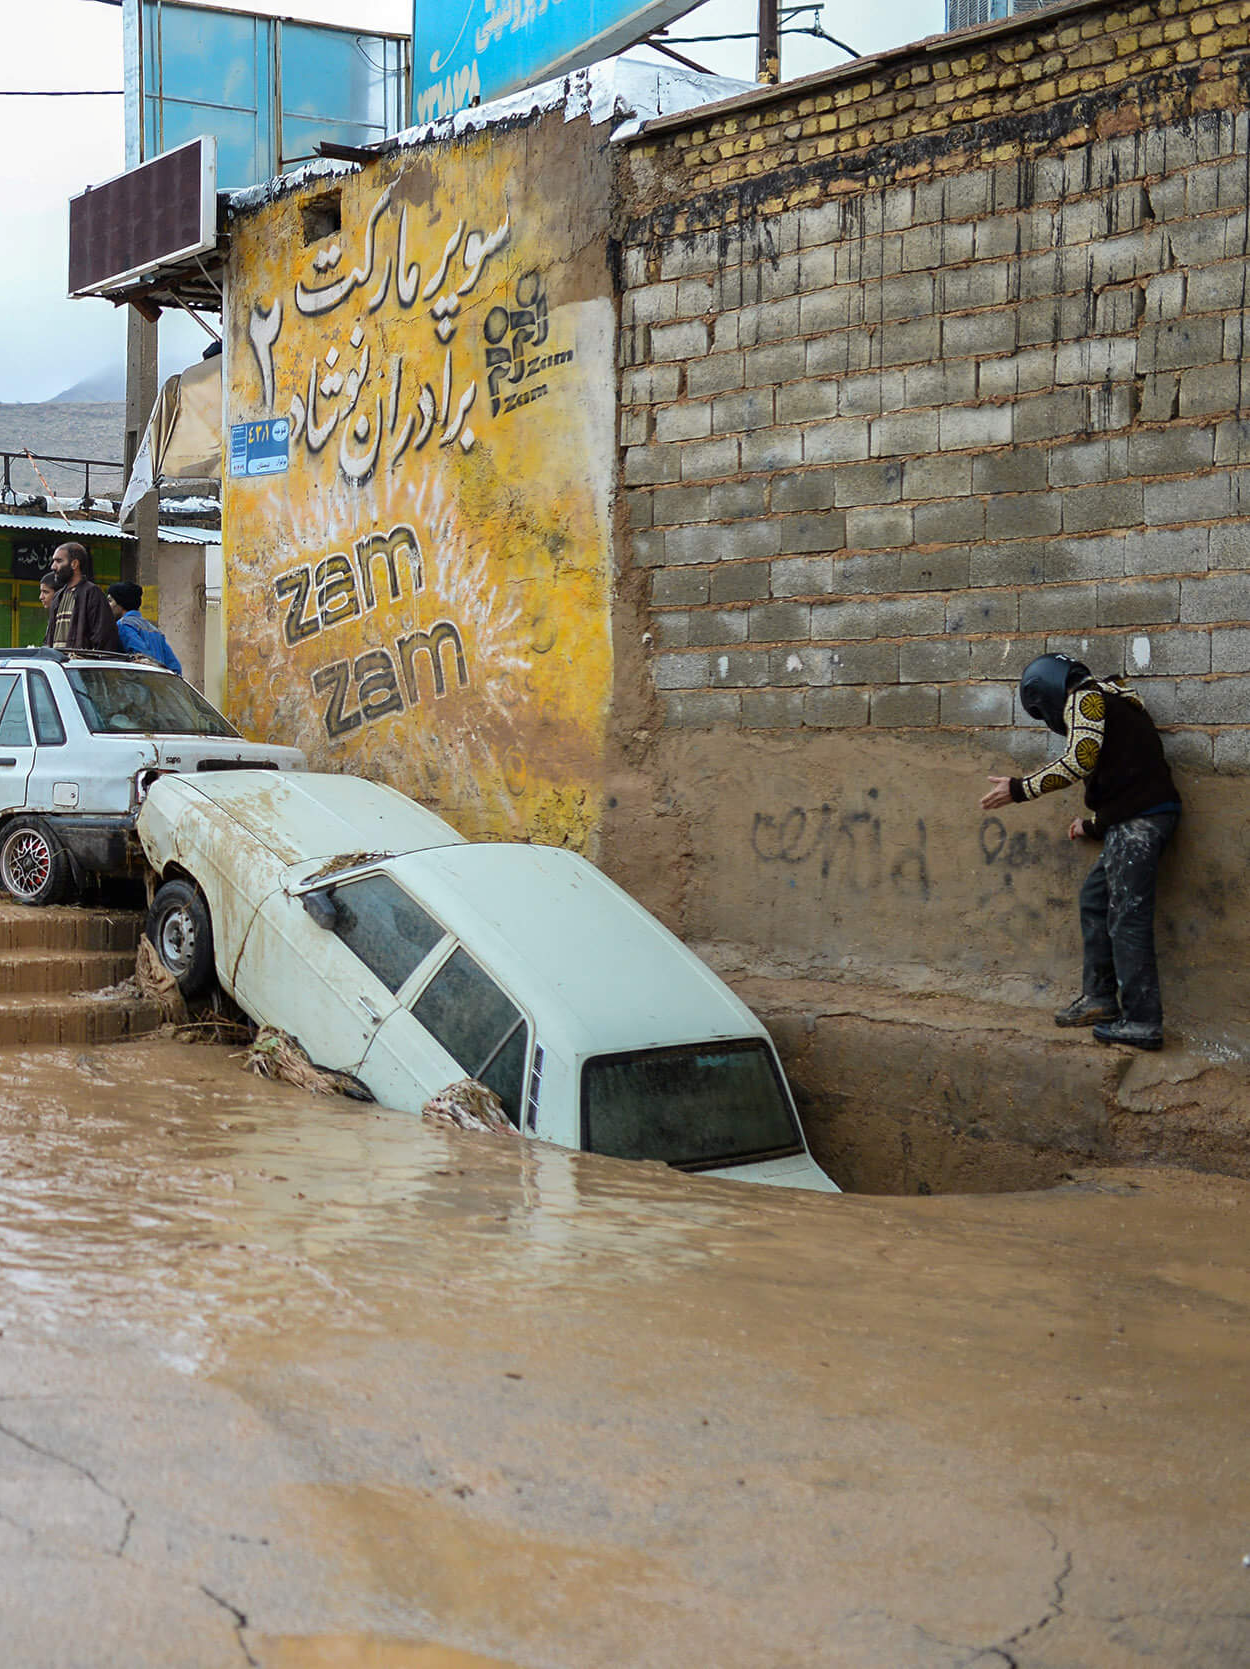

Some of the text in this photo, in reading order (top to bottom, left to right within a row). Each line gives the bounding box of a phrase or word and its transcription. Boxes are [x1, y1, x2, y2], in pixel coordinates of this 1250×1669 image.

[294, 164, 422, 317] مارکت
[502, 383, 549, 415] zam
[273, 523, 426, 648] zam
[310, 619, 470, 743] zam
